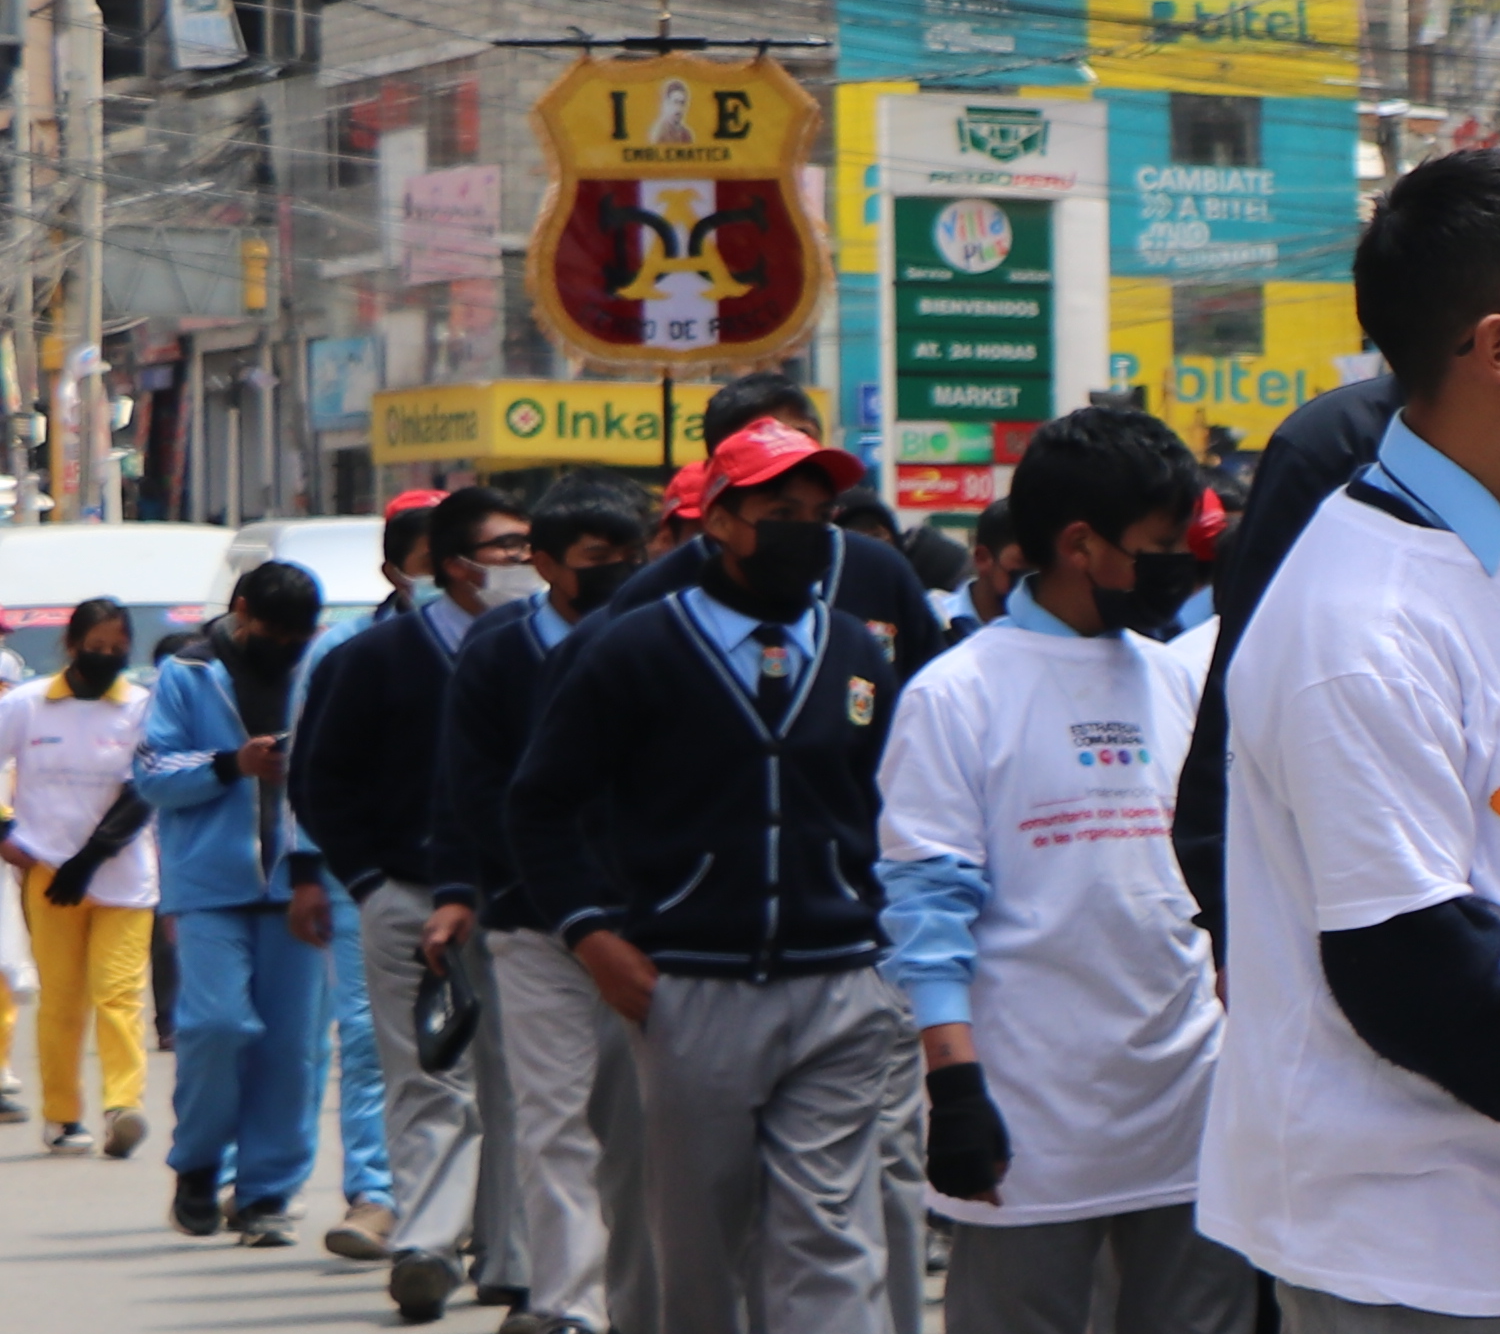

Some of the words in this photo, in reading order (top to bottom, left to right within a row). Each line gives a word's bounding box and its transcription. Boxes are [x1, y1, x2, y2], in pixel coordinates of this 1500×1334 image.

[1194, 0, 1309, 44] bitel
[609, 90, 629, 141] I
[713, 90, 752, 141] E
[1136, 166, 1275, 196] CAMBIATE
[918, 298, 1040, 319] BIENVENIDOS
[668, 319, 698, 341] DE
[948, 342, 972, 360] 24
[976, 342, 1037, 361] HORAS
[1173, 355, 1307, 409] bitel
[932, 384, 1022, 408] MARKET
